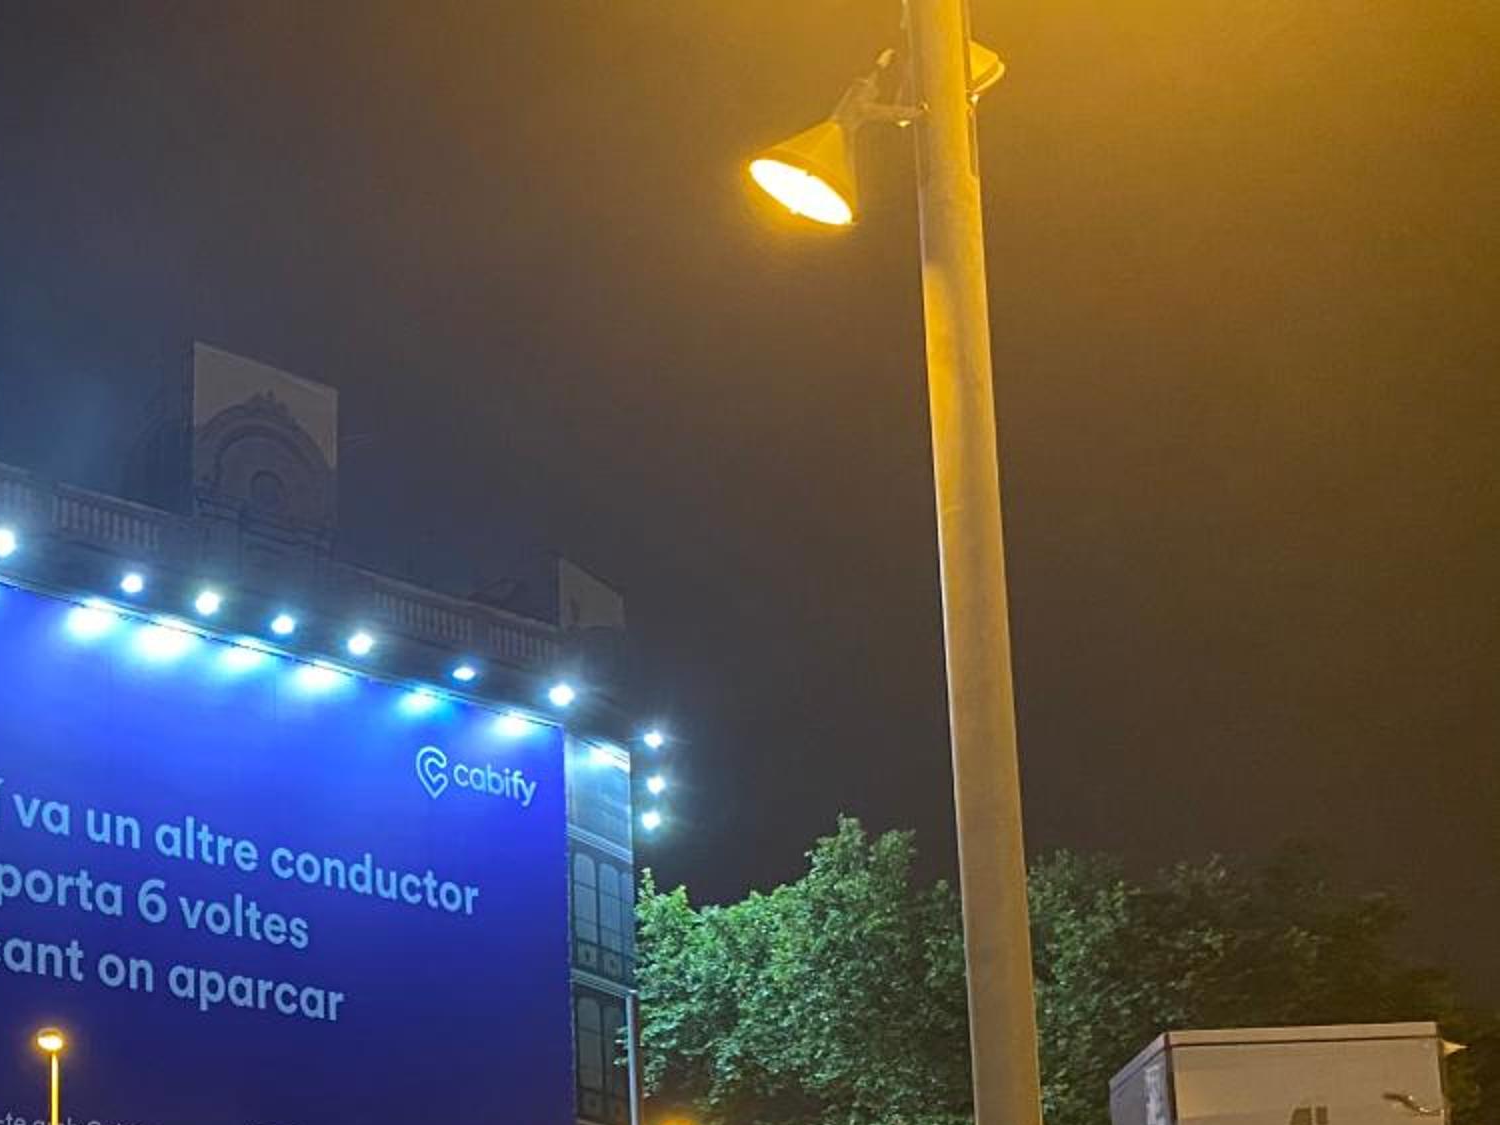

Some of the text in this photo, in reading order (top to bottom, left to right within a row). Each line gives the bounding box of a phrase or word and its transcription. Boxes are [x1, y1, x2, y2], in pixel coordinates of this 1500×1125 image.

[452, 763, 537, 807] cabify
[13, 793, 70, 836] va
[87, 808, 140, 849] un
[155, 815, 259, 871] altre
[271, 847, 479, 915] conductor
[137, 879, 168, 924] 6
[179, 893, 309, 949] voltes
[98, 953, 153, 993] on
[168, 961, 344, 1022] aparcar
